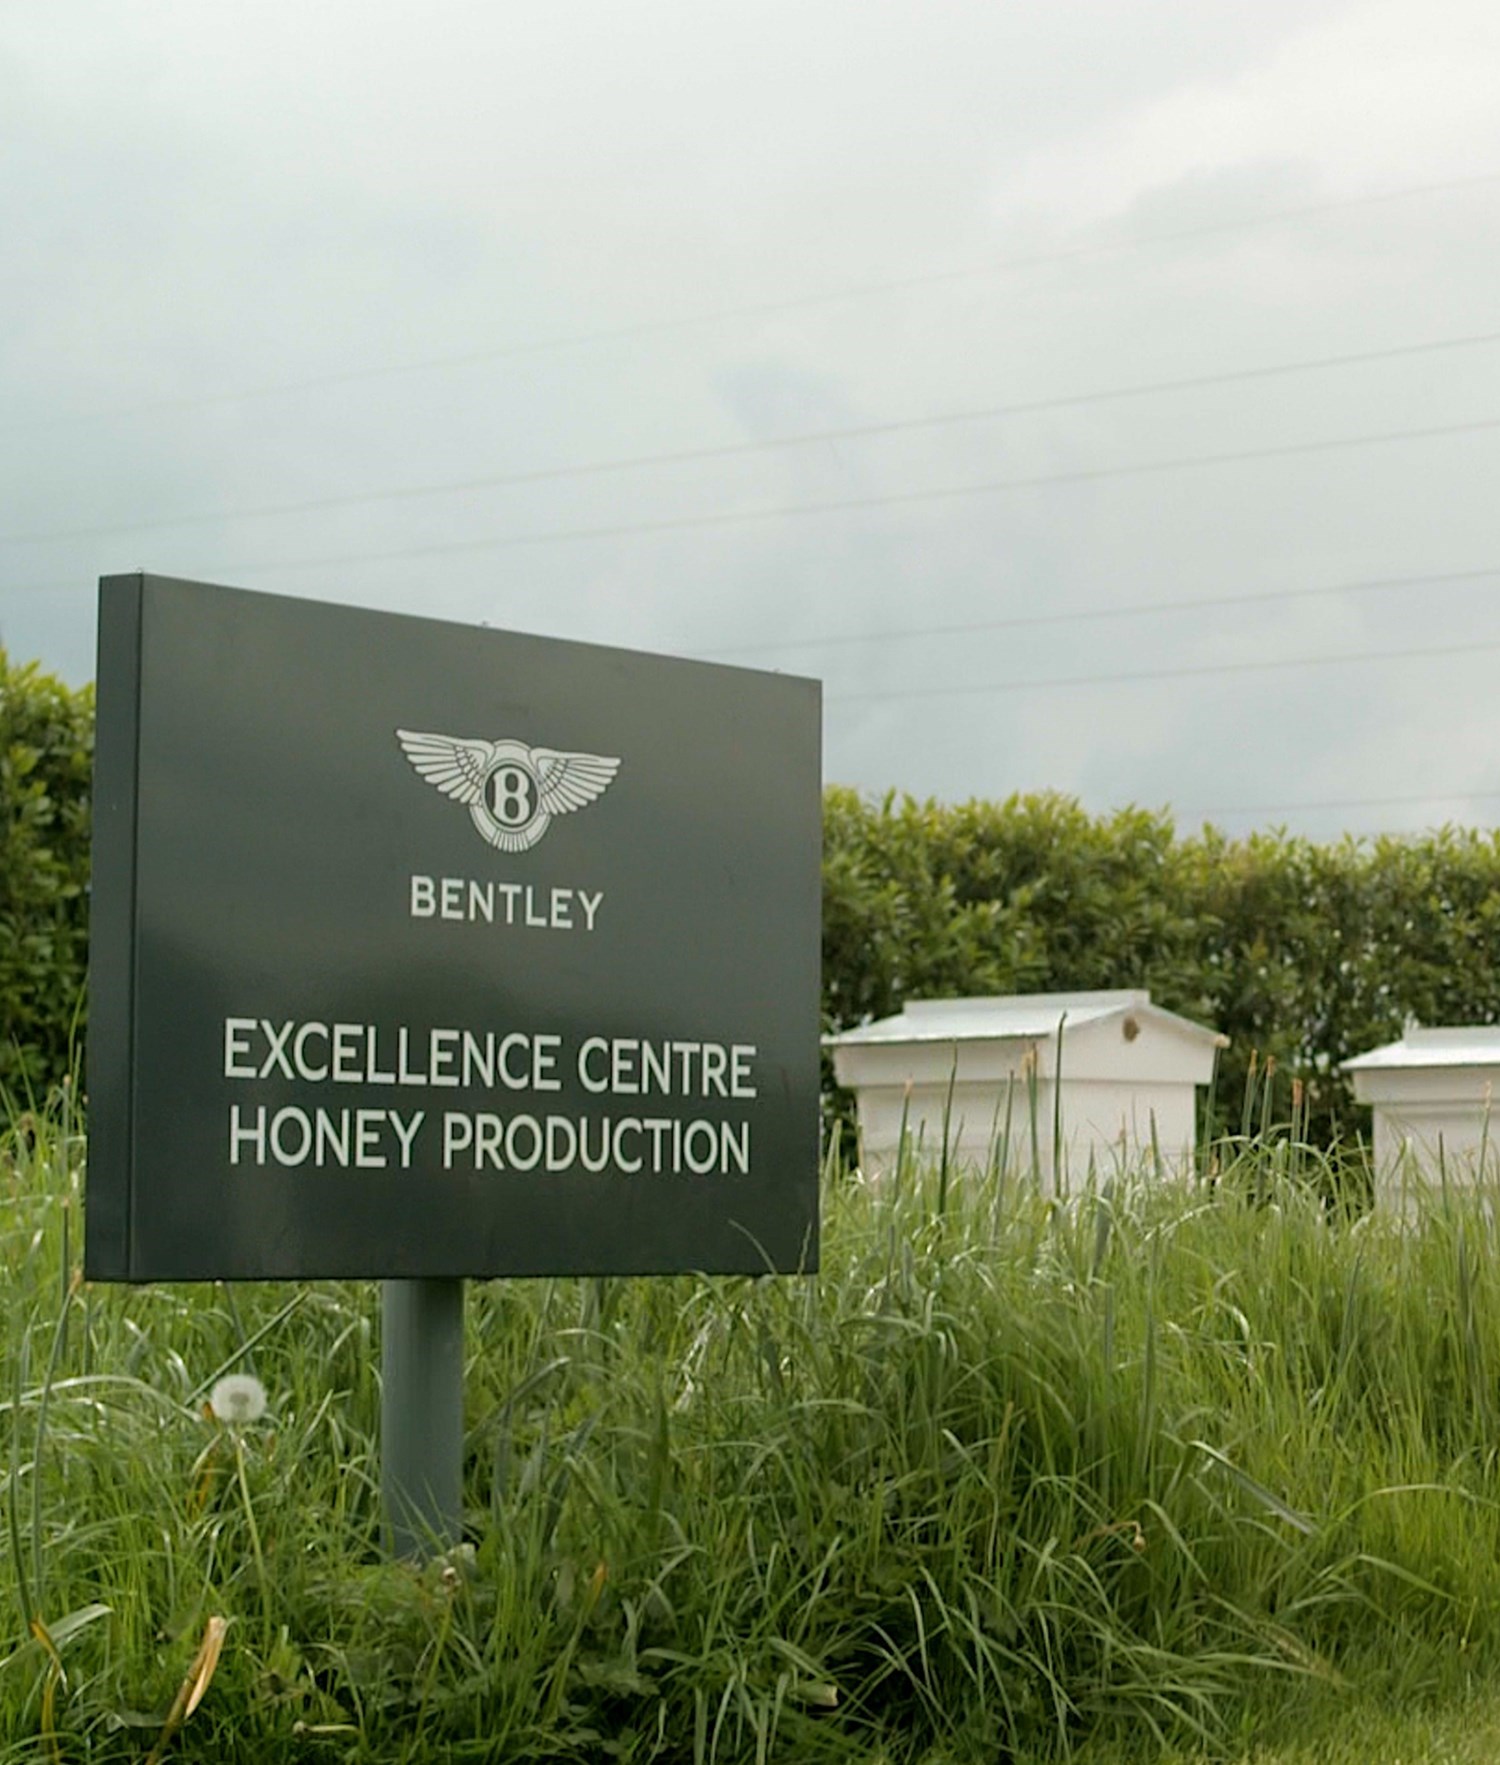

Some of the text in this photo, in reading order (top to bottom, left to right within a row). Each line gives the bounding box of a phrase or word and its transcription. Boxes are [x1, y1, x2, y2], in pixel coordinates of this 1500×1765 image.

[492, 766, 531, 826] B
[410, 874, 605, 932] BENTLEY
[223, 1016, 758, 1099] EXCELLENCE CENTRE
[229, 1103, 751, 1175] HONEY PRODUCTION
